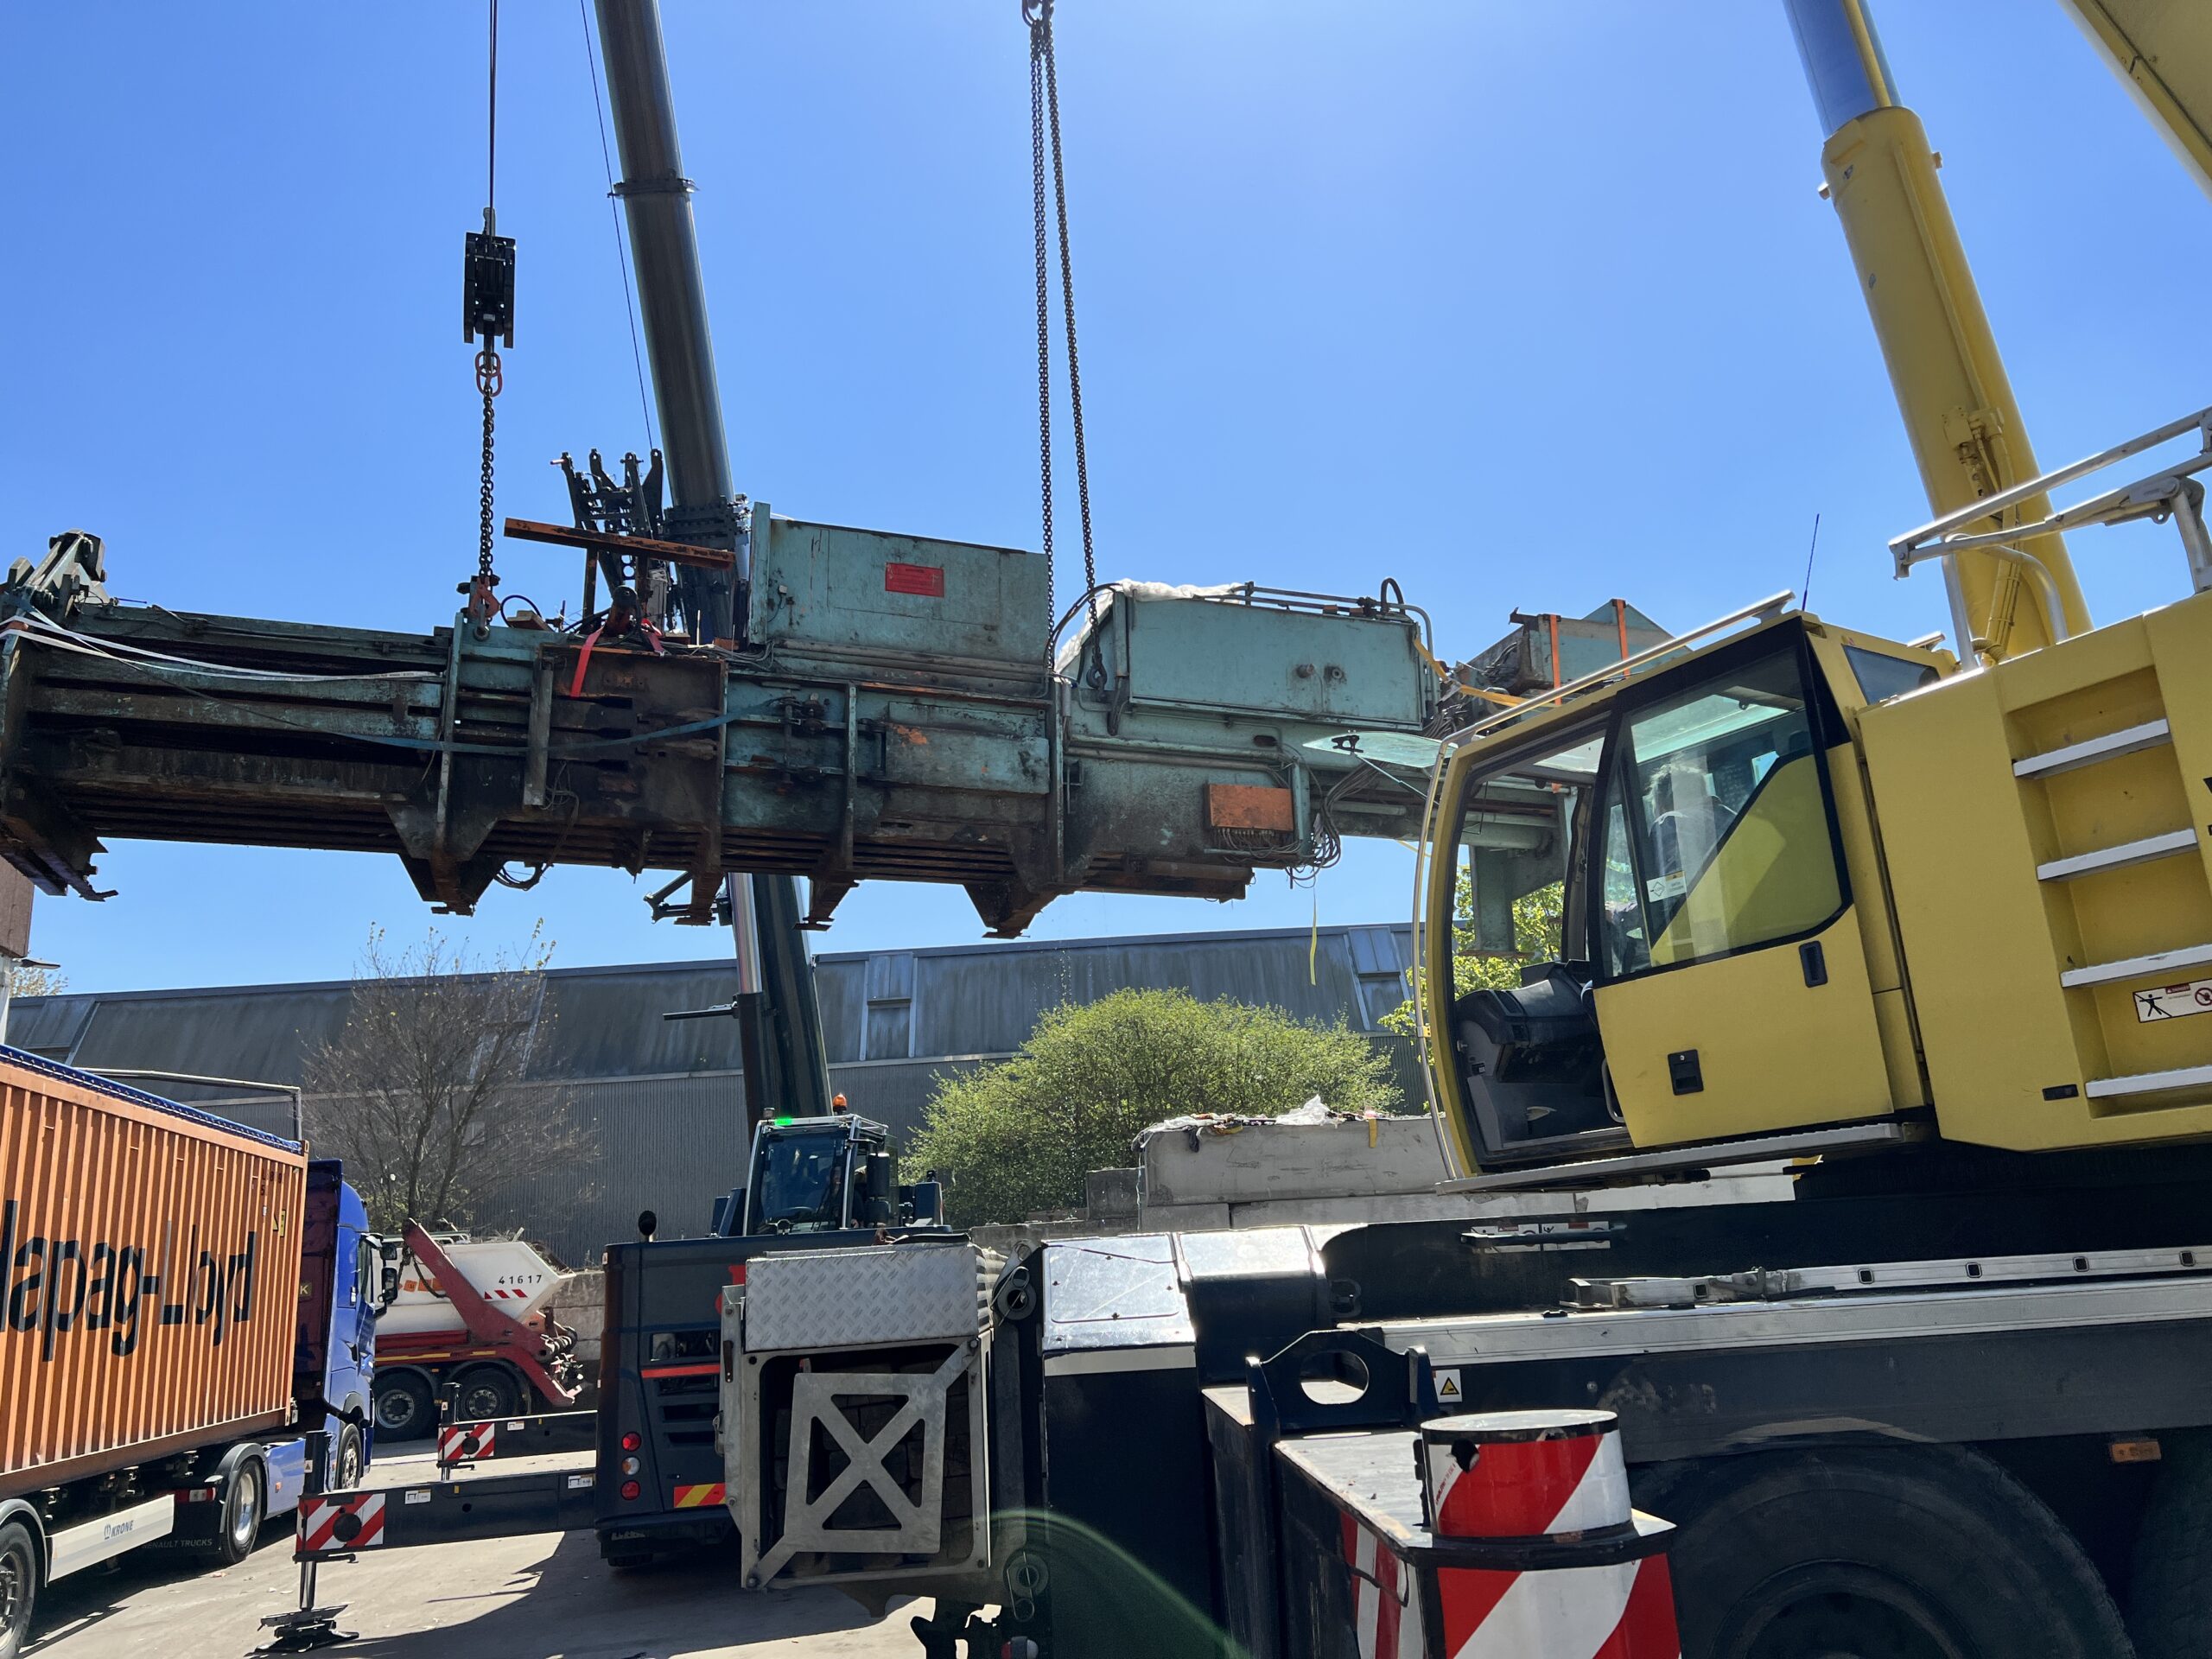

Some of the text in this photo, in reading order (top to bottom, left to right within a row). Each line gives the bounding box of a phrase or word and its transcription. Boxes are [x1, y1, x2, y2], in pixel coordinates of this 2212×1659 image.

[499, 1274, 542, 1285] 41617
[111, 1520, 134, 1537] KRONE
[143, 1538, 213, 1549] ENAULT TRUCKS
